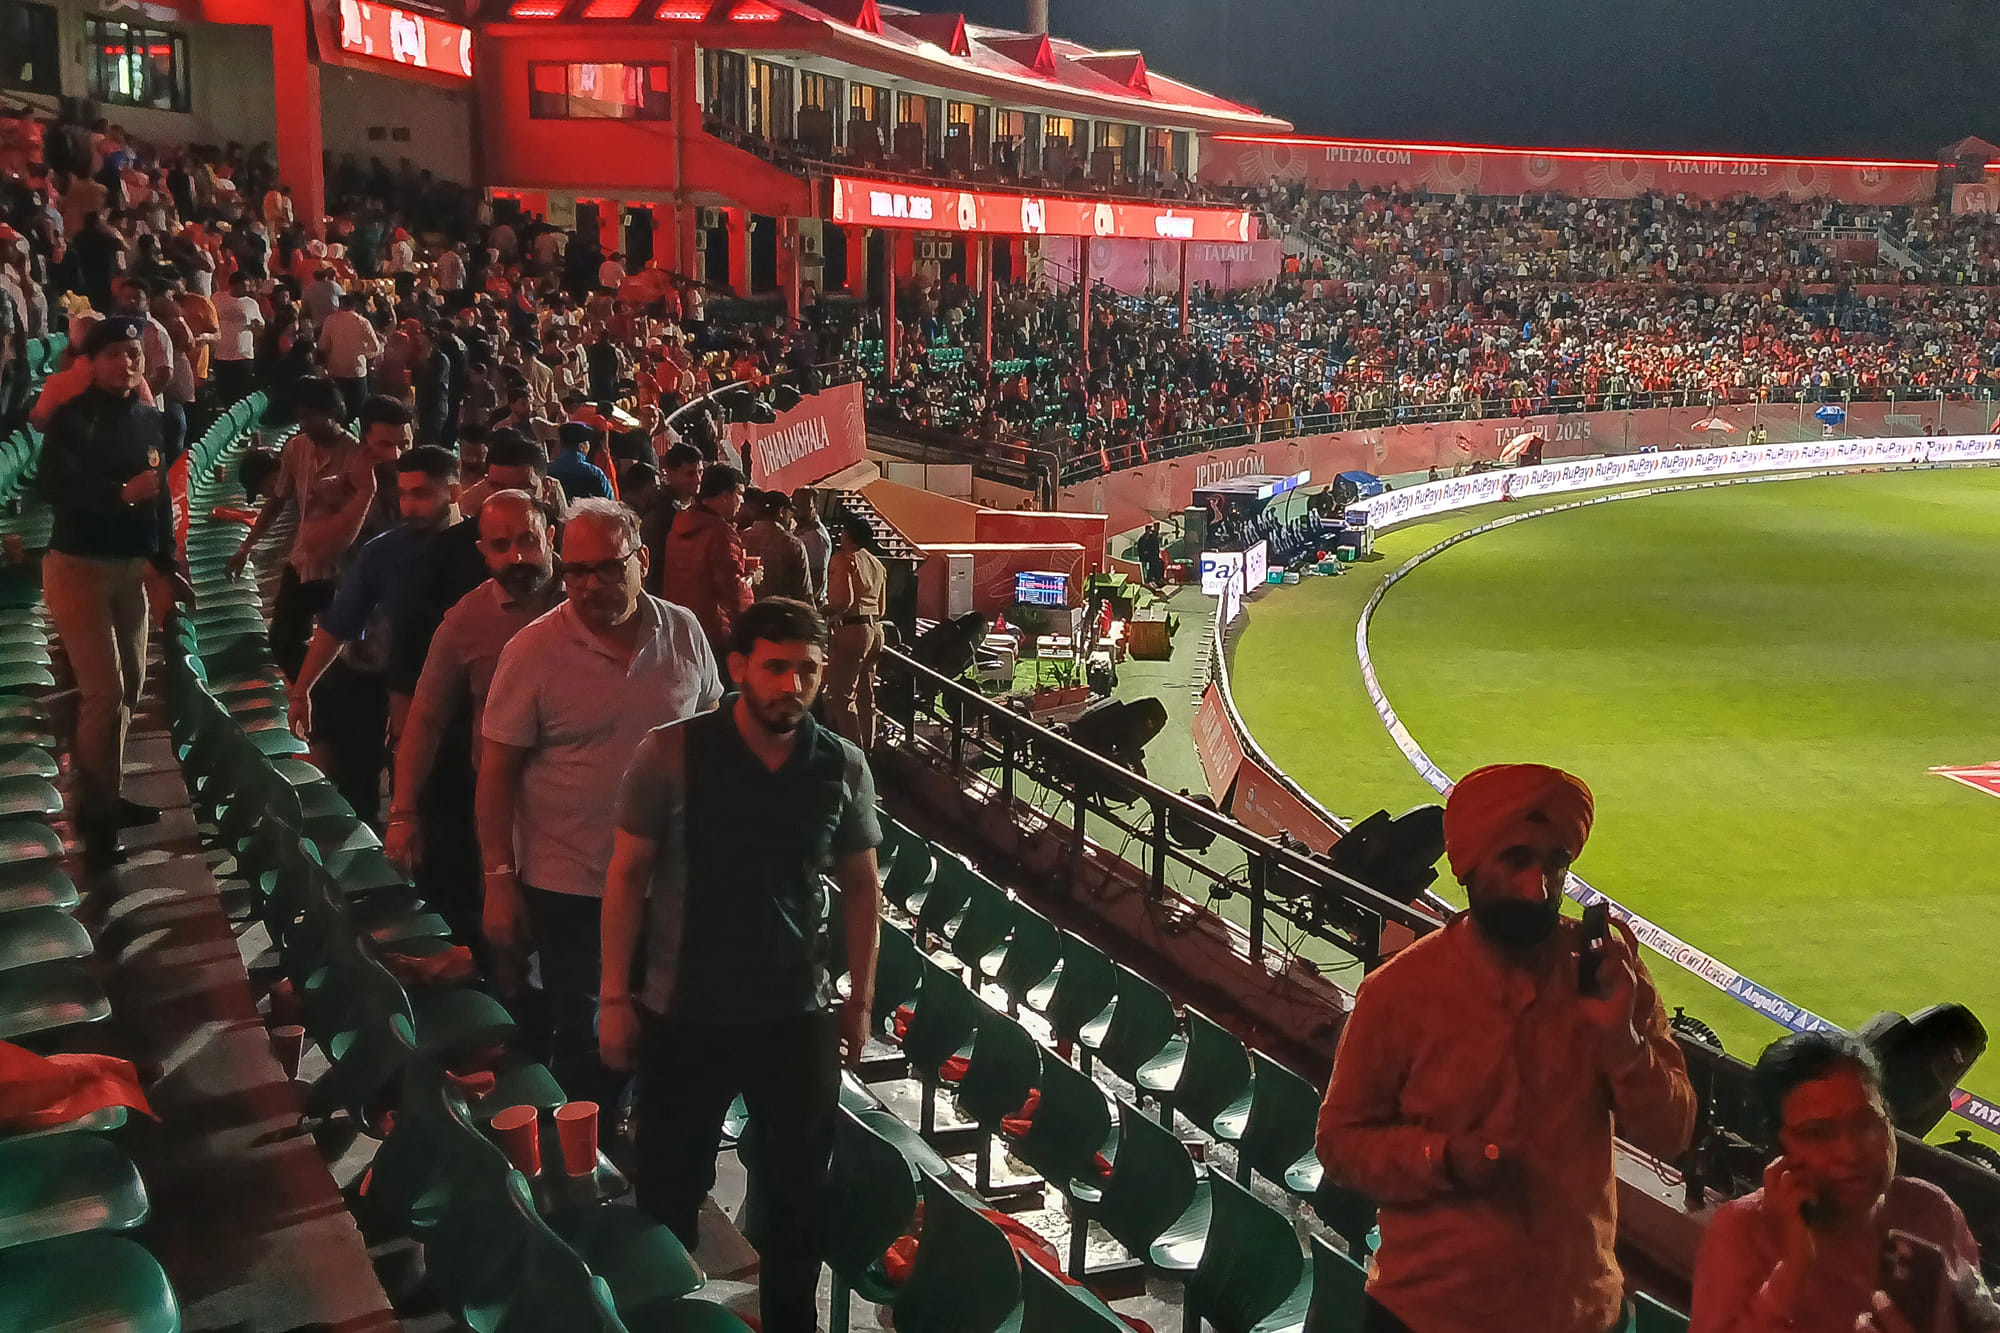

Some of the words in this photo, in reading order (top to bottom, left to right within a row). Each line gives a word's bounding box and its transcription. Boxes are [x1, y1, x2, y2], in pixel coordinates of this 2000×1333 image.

[1325, 147, 1411, 165] IPLT20.COM
[1666, 160, 1700, 174] TATA
[1704, 161, 1725, 175] IPL
[1731, 162, 1768, 176] 2025
[1555, 421, 1590, 441] 2025
[757, 415, 830, 477] DHARAMSHALA
[1196, 454, 1265, 488] IPLT20COM
[1414, 487, 1439, 506] RuPay
[1442, 482, 1467, 500] RuPay
[1471, 476, 1496, 495] RuPay
[1530, 468, 1557, 486] RuPay
[1562, 464, 1590, 482] RuPay
[1594, 461, 1622, 478] RuPay
[1626, 458, 1655, 474] RuPay
[1659, 454, 1689, 471] RuPay
[1694, 452, 1723, 468] RuPay
[1729, 449, 1759, 465] RuPay
[1764, 447, 1795, 463] RuPay
[1800, 445, 1832, 460] RuPay
[1837, 443, 1869, 458] RuPay
[1875, 441, 1908, 457] RuPay
[1954, 438, 1987, 454] RuPay
